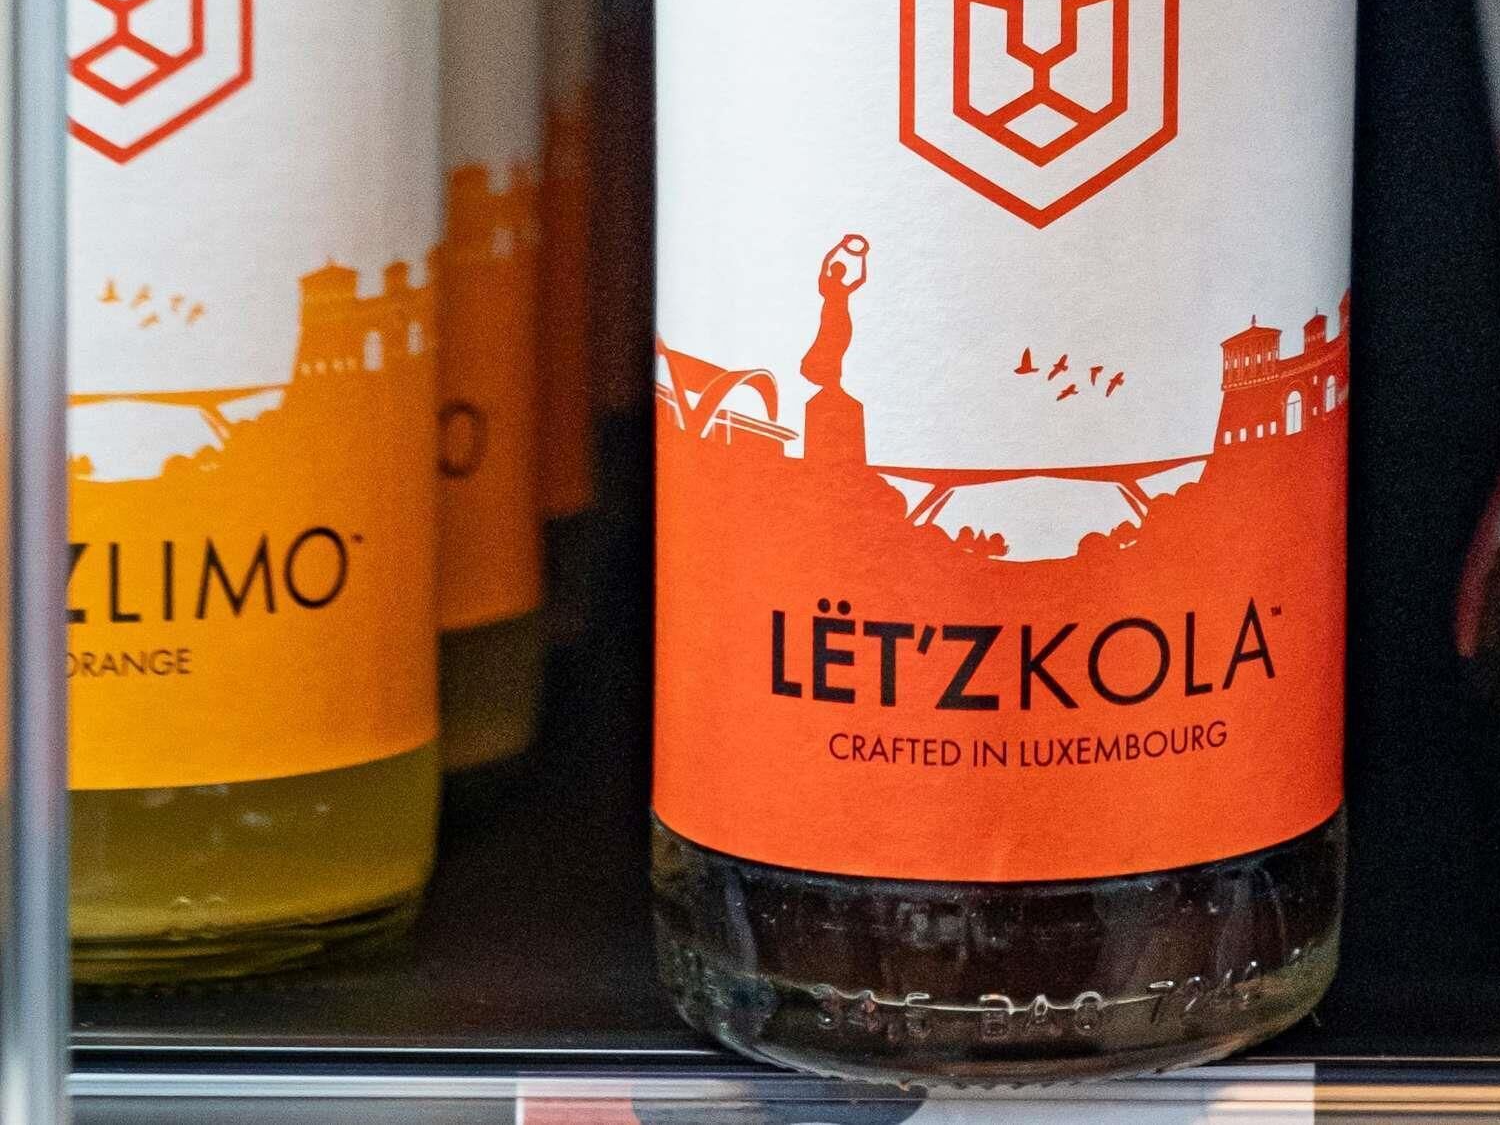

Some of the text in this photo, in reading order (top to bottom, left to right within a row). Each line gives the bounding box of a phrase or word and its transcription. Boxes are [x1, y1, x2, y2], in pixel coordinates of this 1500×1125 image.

[829, 720, 1229, 768] CRAFTED IN LUXEMBOURG
